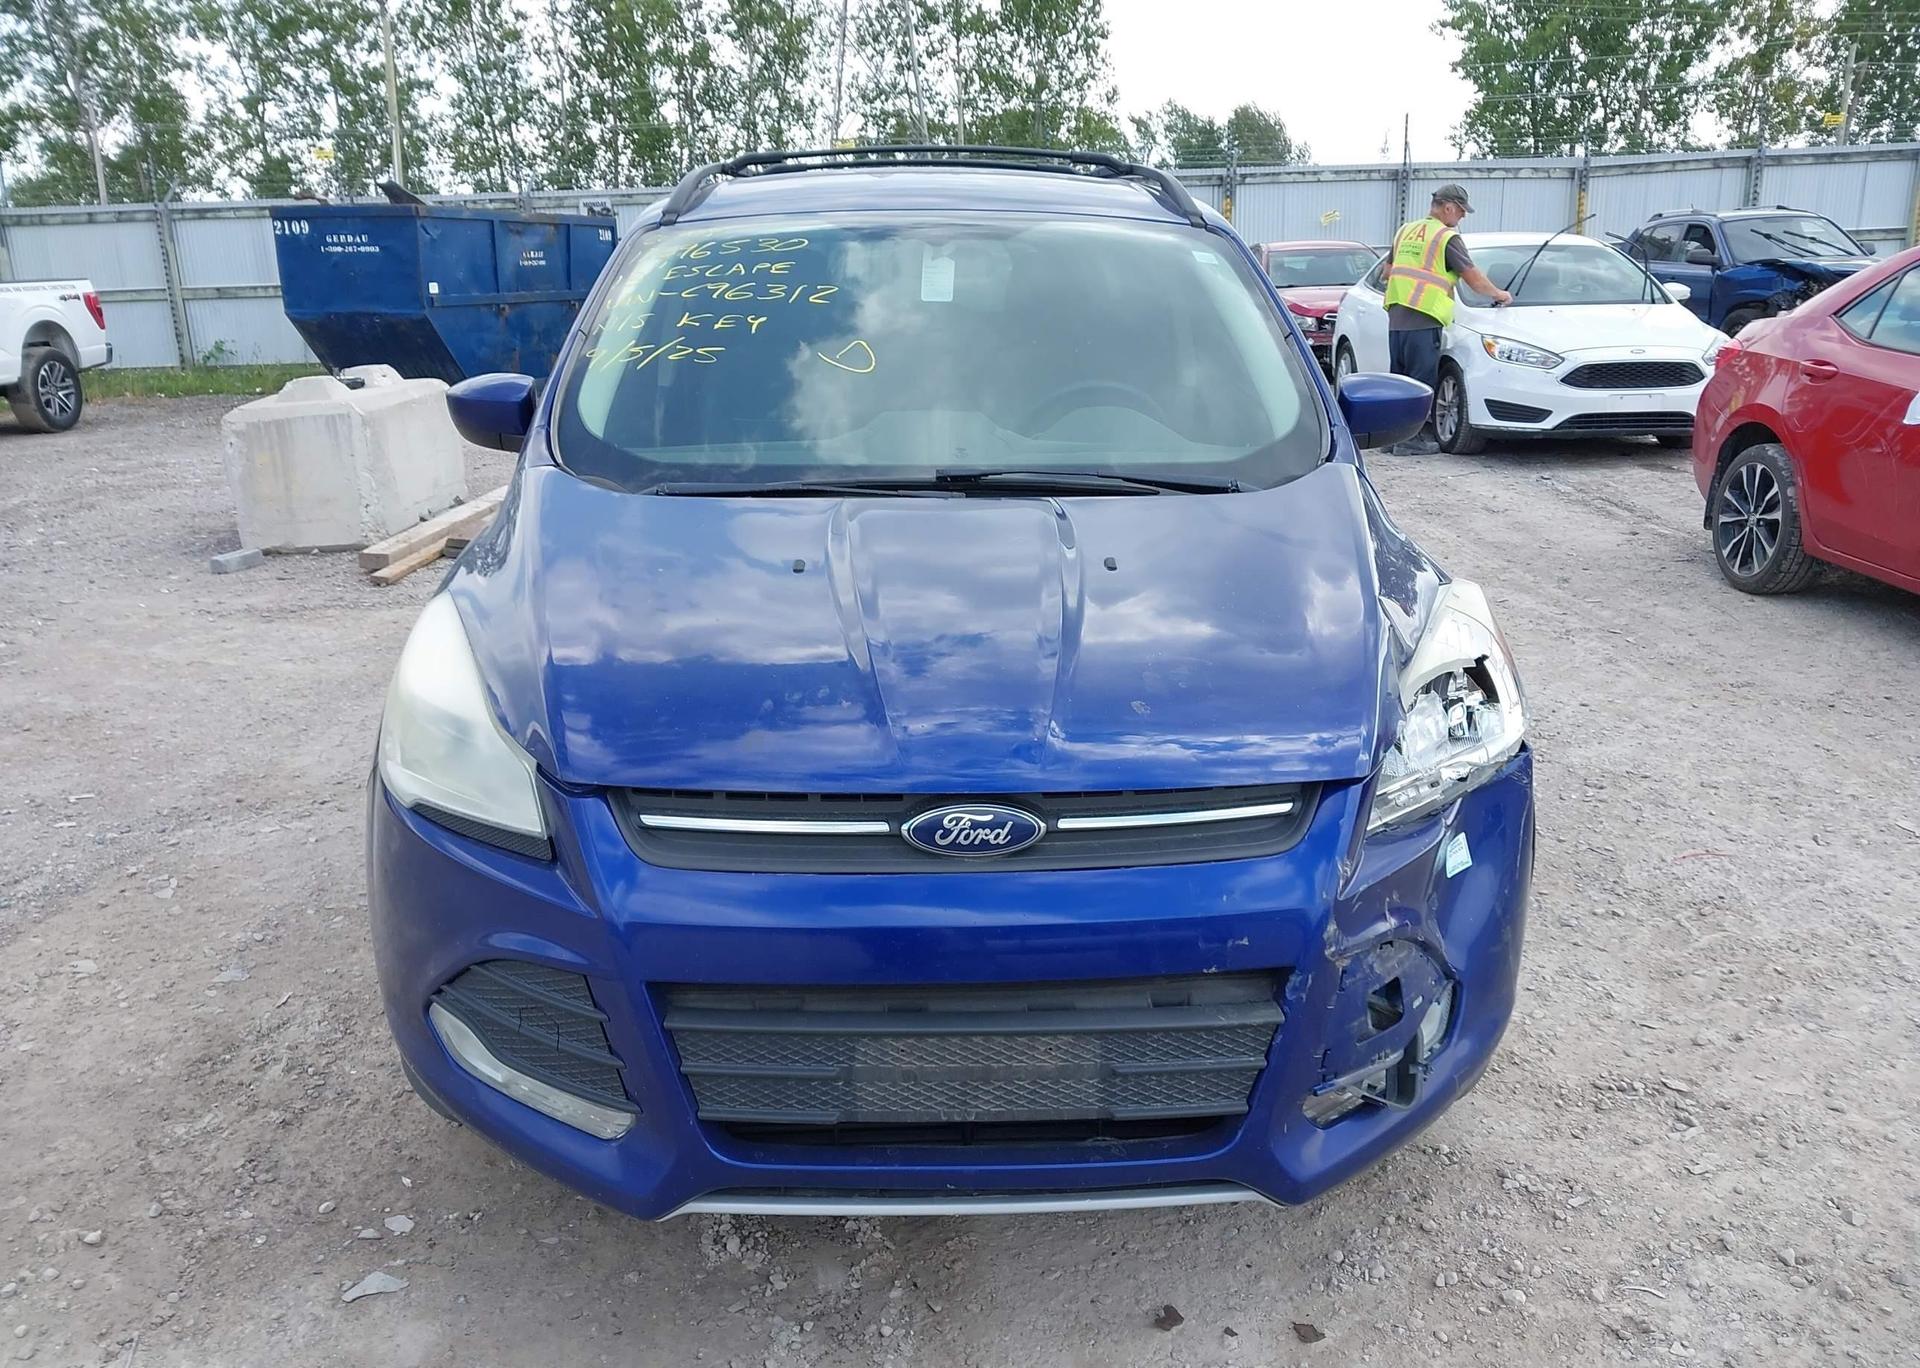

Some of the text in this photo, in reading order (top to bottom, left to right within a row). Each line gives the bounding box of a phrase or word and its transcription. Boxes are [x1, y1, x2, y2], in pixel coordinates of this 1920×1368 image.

[273, 219, 310, 235] 2109
[663, 261, 797, 280] ESCAPE
[676, 311, 768, 334] KEY
[934, 813, 1014, 846] Ford
